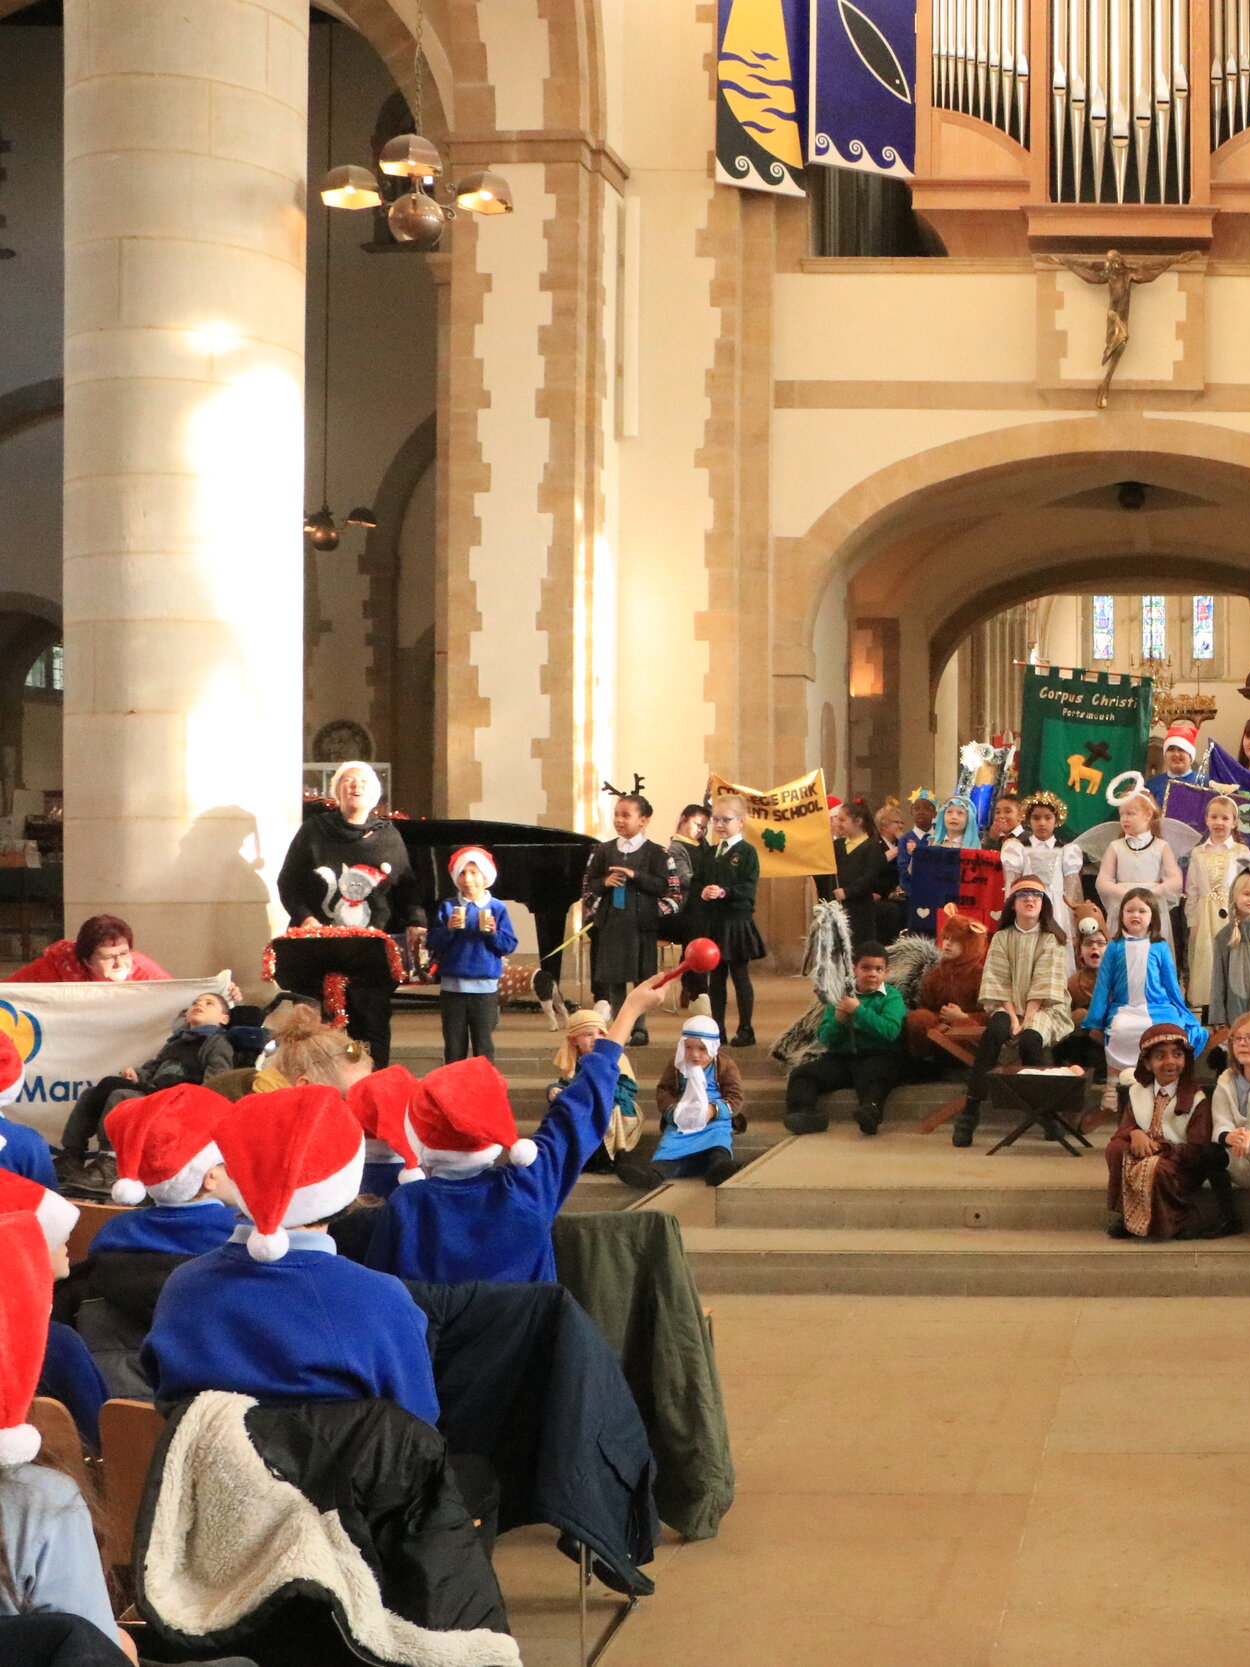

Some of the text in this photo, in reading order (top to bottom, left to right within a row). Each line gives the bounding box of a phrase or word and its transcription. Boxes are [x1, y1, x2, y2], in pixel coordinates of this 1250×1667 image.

[1039, 687, 1138, 709] Corpus Christi
[1062, 708, 1115, 721] Portsmouth
[781, 783, 818, 803] PARK
[773, 800, 823, 821] SCHOOL
[16, 1075, 97, 1103] Mar
